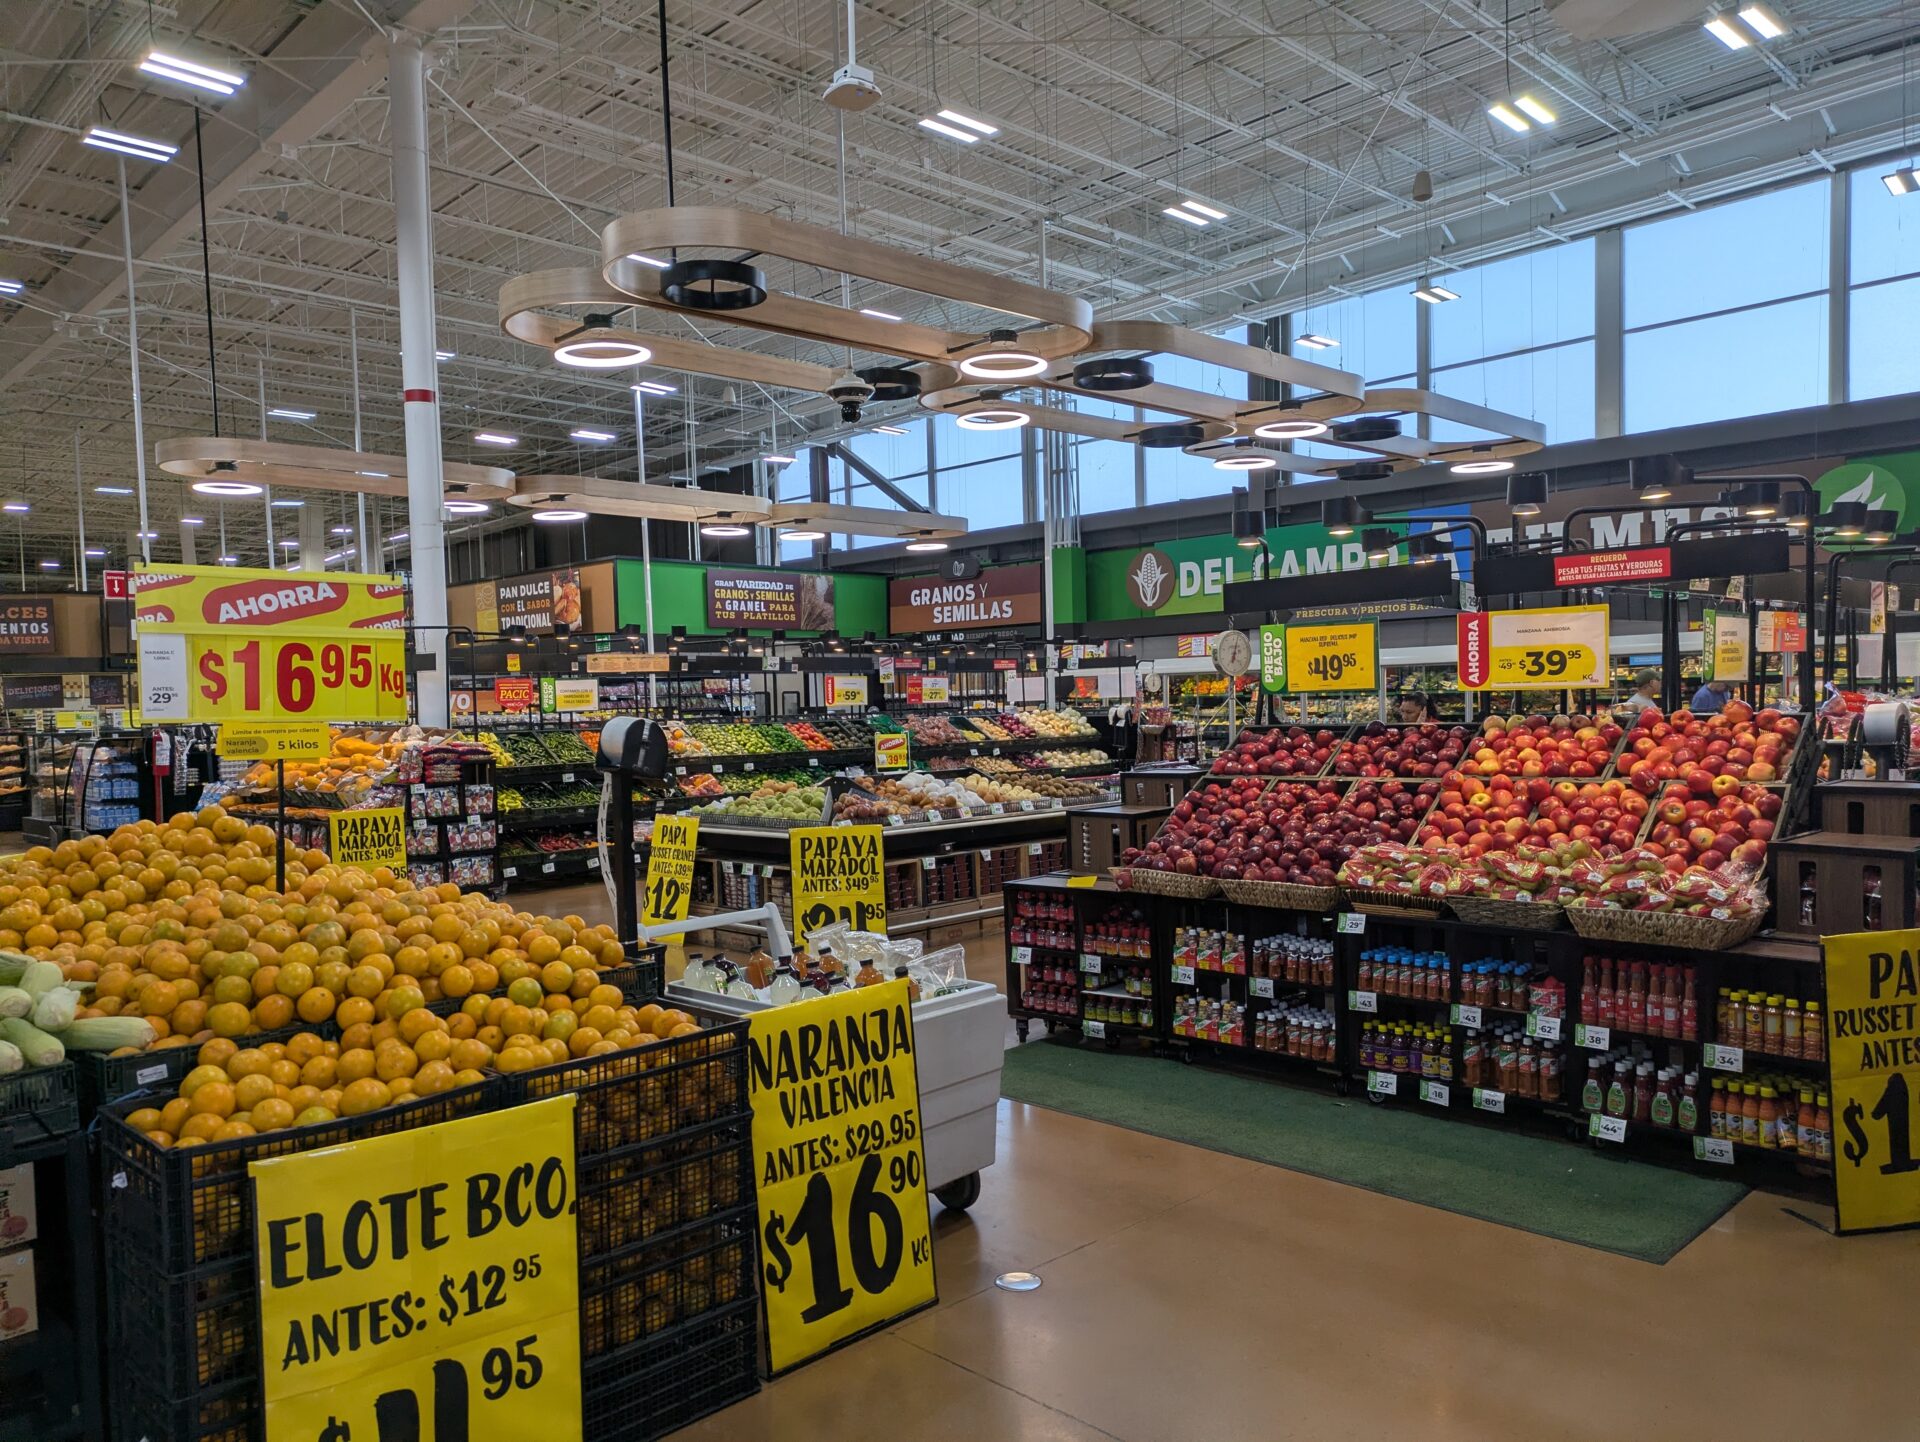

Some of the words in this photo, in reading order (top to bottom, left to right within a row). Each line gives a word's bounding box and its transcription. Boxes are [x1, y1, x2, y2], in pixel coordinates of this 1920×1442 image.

[1558, 567, 1579, 575] PESAR
[1594, 563, 1618, 571] FRUTAS
[1626, 560, 1663, 569] VERDURAS
[1590, 554, 1627, 563] RECUERDA
[500, 586, 518, 599] PAN
[520, 581, 550, 596] DULCE
[715, 589, 749, 599] GRANOS
[756, 591, 794, 601] SEMILLAS
[736, 580, 784, 590] VARIEDAD
[910, 583, 976, 606] GRANOS
[979, 582, 988, 598] Y
[218, 582, 337, 623] AHORRA
[501, 602, 515, 612] CON
[517, 600, 525, 612] EL
[527, 599, 550, 609] SABOR
[715, 601, 722, 609] A
[725, 600, 766, 612] GRANEL
[933, 600, 1013, 624] SEMILLAS
[1296, 606, 1348, 618] FRESCURA
[1351, 606, 1359, 616] Y
[1361, 603, 1407, 615] PRECIOS
[363, 617, 404, 629] ORR
[501, 612, 551, 630] TRADICIONAL
[715, 611, 735, 619] TUS
[743, 612, 796, 621] PLATILLOS
[0, 622, 49, 634] ENTOS
[13, 635, 50, 645] VISITA
[1264, 632, 1274, 683] PRECIO
[1273, 637, 1283, 676] BAJO
[1468, 620, 1479, 684] AHORRA
[380, 664, 404, 698] Kg
[226, 739, 257, 747] Naranja
[277, 741, 286, 750] 5
[289, 739, 319, 749] kilos
[880, 738, 904, 751] AHORRA
[337, 815, 402, 837] PAPAYA
[661, 825, 687, 847] PAPA
[338, 833, 402, 852] MARADOL
[800, 834, 879, 860] PAPAYA
[340, 850, 374, 863] ANTES:
[649, 845, 673, 859] RUSSET
[672, 849, 695, 862] GRANEL
[653, 861, 673, 874] ANTES:
[800, 856, 880, 879] MARADOL
[802, 878, 842, 893] ANTES:
[1868, 949, 1920, 999] PA
[1833, 1003, 1917, 1038] RUSSET
[749, 1004, 911, 1094] NARANJA
[779, 1063, 895, 1129] VALENCIA
[1842, 1072, 1920, 1176] $1
[763, 1137, 840, 1188] ANTES:
[846, 1108, 916, 1162] $29.95
[267, 1182, 449, 1289] ELOTE
[465, 1156, 577, 1239] BCO.
[912, 1235, 929, 1267] KG
[282, 1290, 427, 1371] ANTES:
